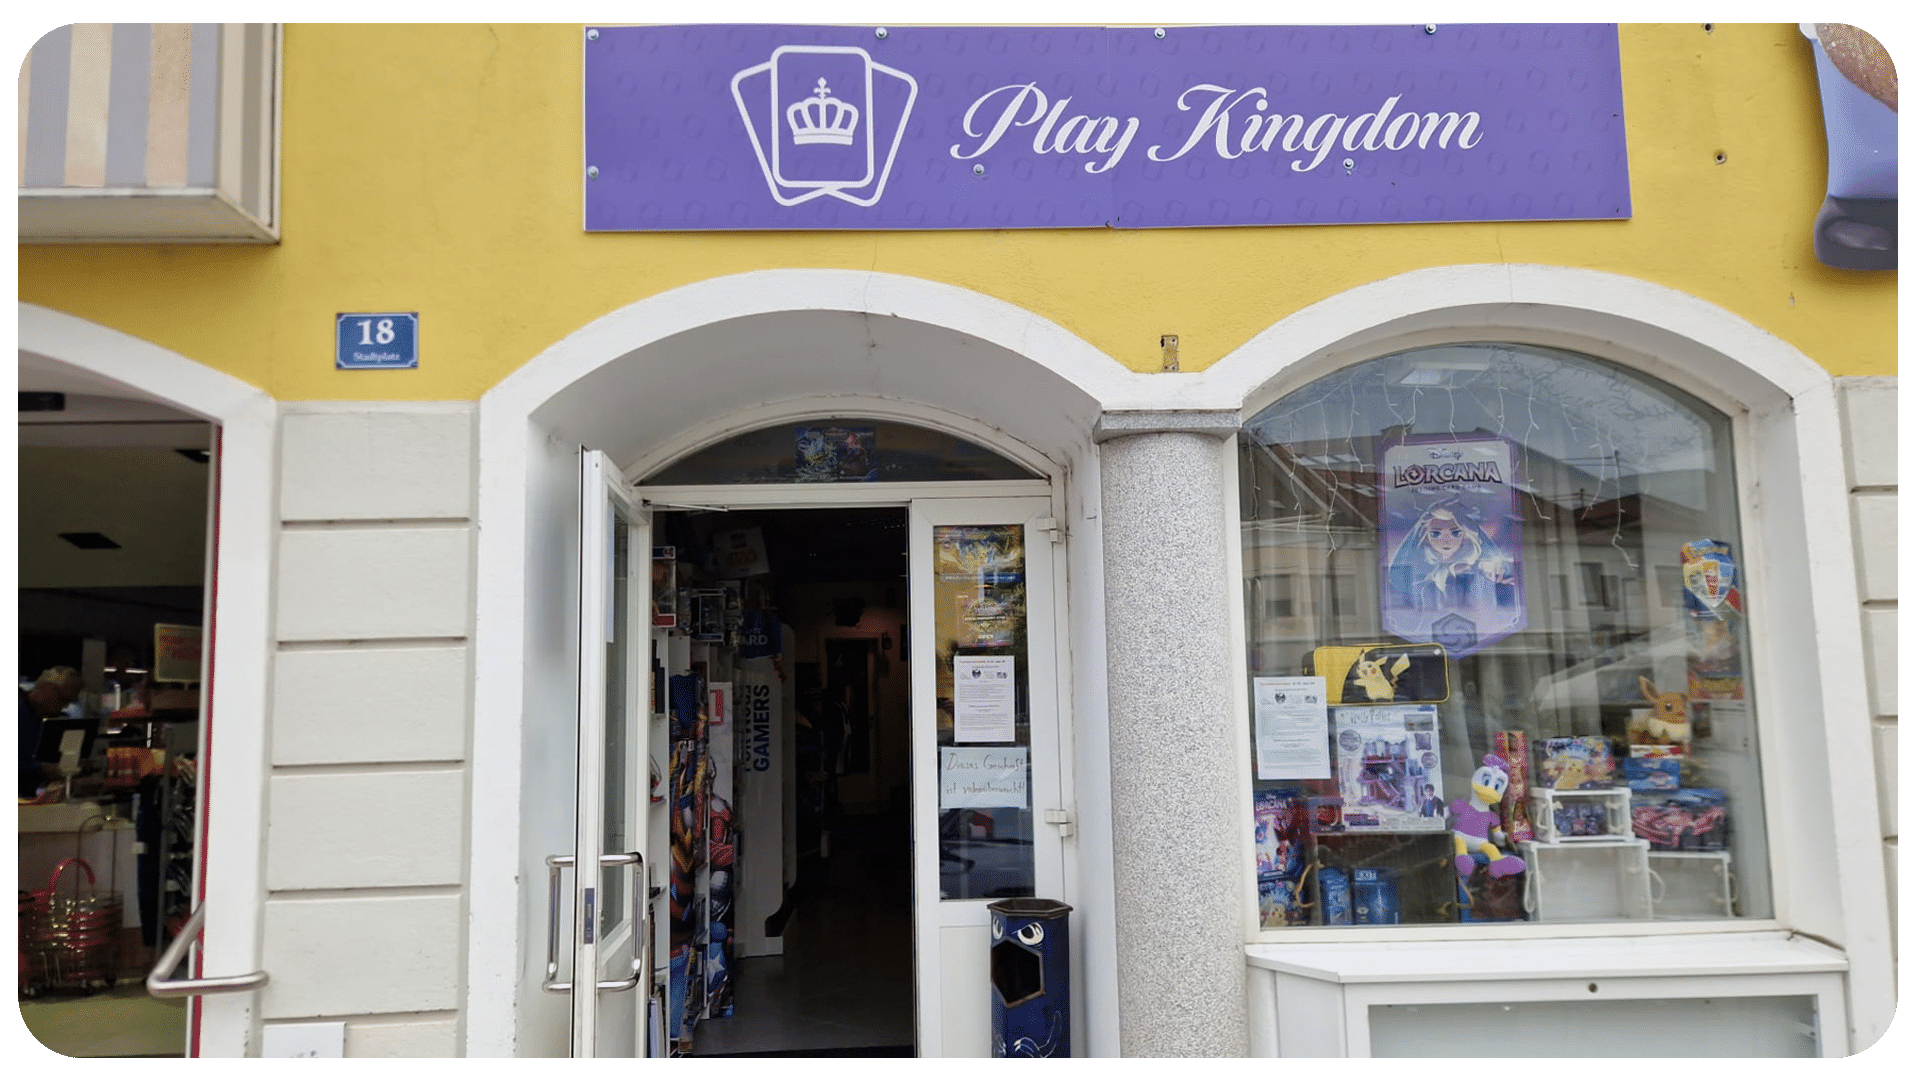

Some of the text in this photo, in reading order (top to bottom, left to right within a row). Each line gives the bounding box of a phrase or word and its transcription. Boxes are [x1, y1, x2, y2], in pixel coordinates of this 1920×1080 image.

[949, 80, 1484, 174] Play Kingdom
[356, 318, 396, 346] 18
[1393, 460, 1503, 489] LORCANA
[752, 683, 770, 773] GAMERS
